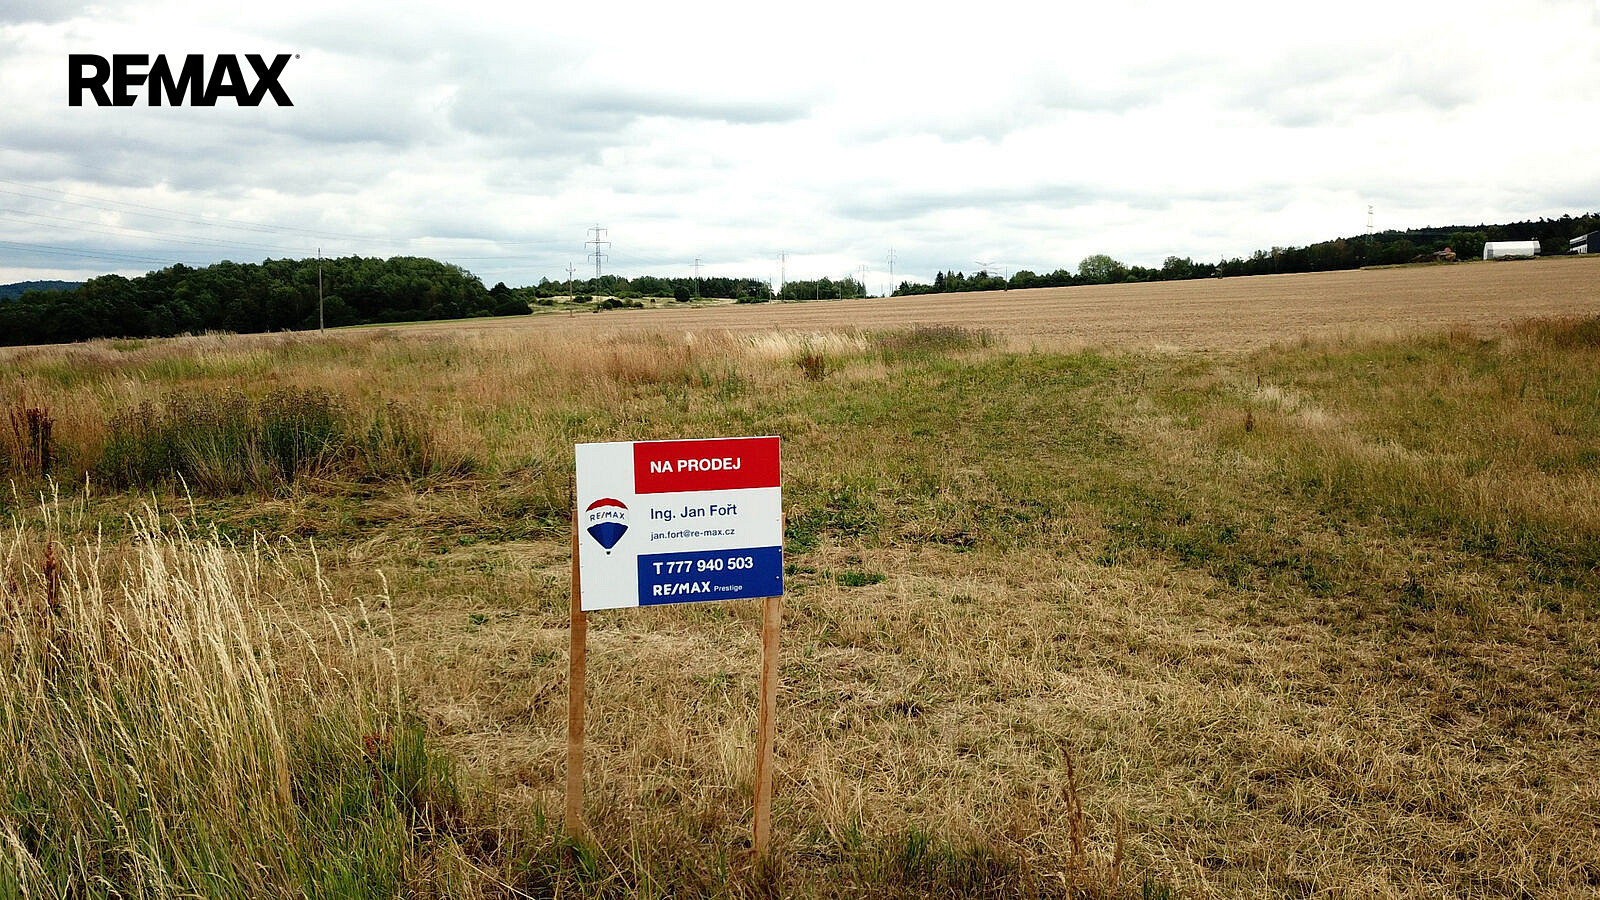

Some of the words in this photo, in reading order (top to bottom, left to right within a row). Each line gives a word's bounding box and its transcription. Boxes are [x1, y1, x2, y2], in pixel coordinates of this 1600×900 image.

[650, 460, 673, 473] NA
[677, 457, 741, 472] PRODEJ
[590, 511, 625, 521] RE/MAX
[650, 507, 676, 522] Ing.
[680, 506, 705, 518] Jan
[709, 503, 738, 516] Fořt
[650, 528, 735, 541] jan.fort@re-max.cz
[653, 562, 663, 575] T
[666, 560, 693, 574] 777
[696, 558, 724, 572] 940
[727, 556, 754, 570] 503
[653, 581, 711, 596] RE/MAX
[713, 584, 743, 592] Prestige
